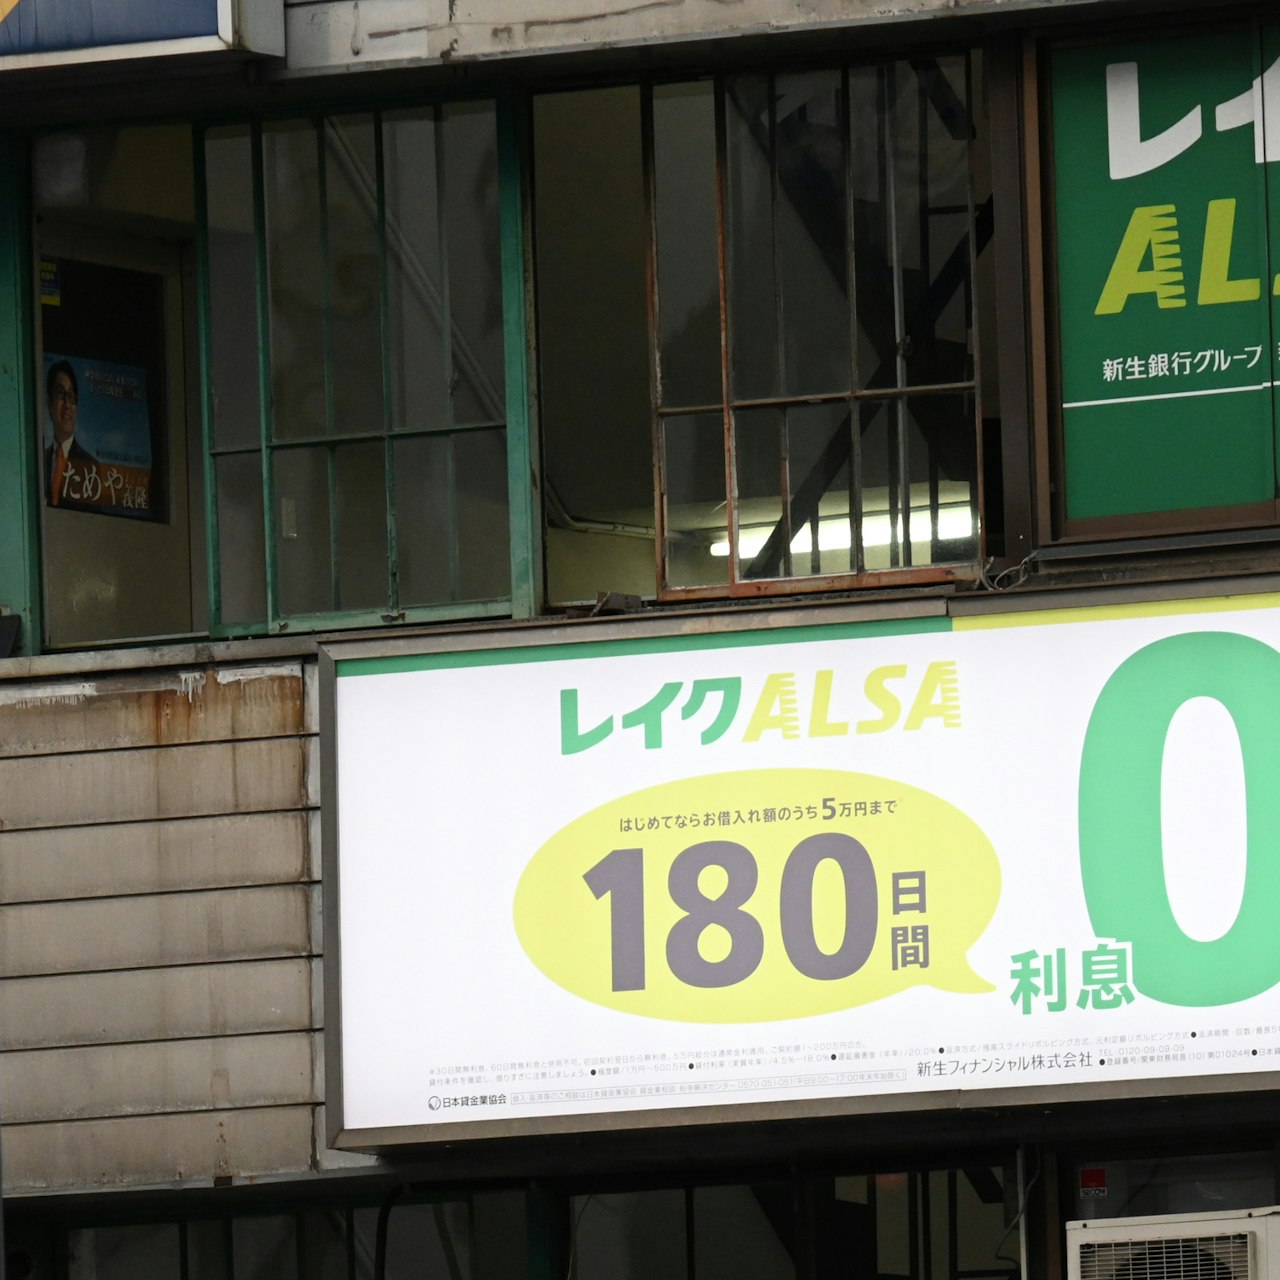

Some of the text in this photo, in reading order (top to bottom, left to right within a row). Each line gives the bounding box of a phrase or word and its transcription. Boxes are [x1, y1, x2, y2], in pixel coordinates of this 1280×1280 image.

[1102, 344, 1262, 382] 新生銀行グループ
[917, 1052, 1093, 1077] 新生フィナンシャル株式会社
